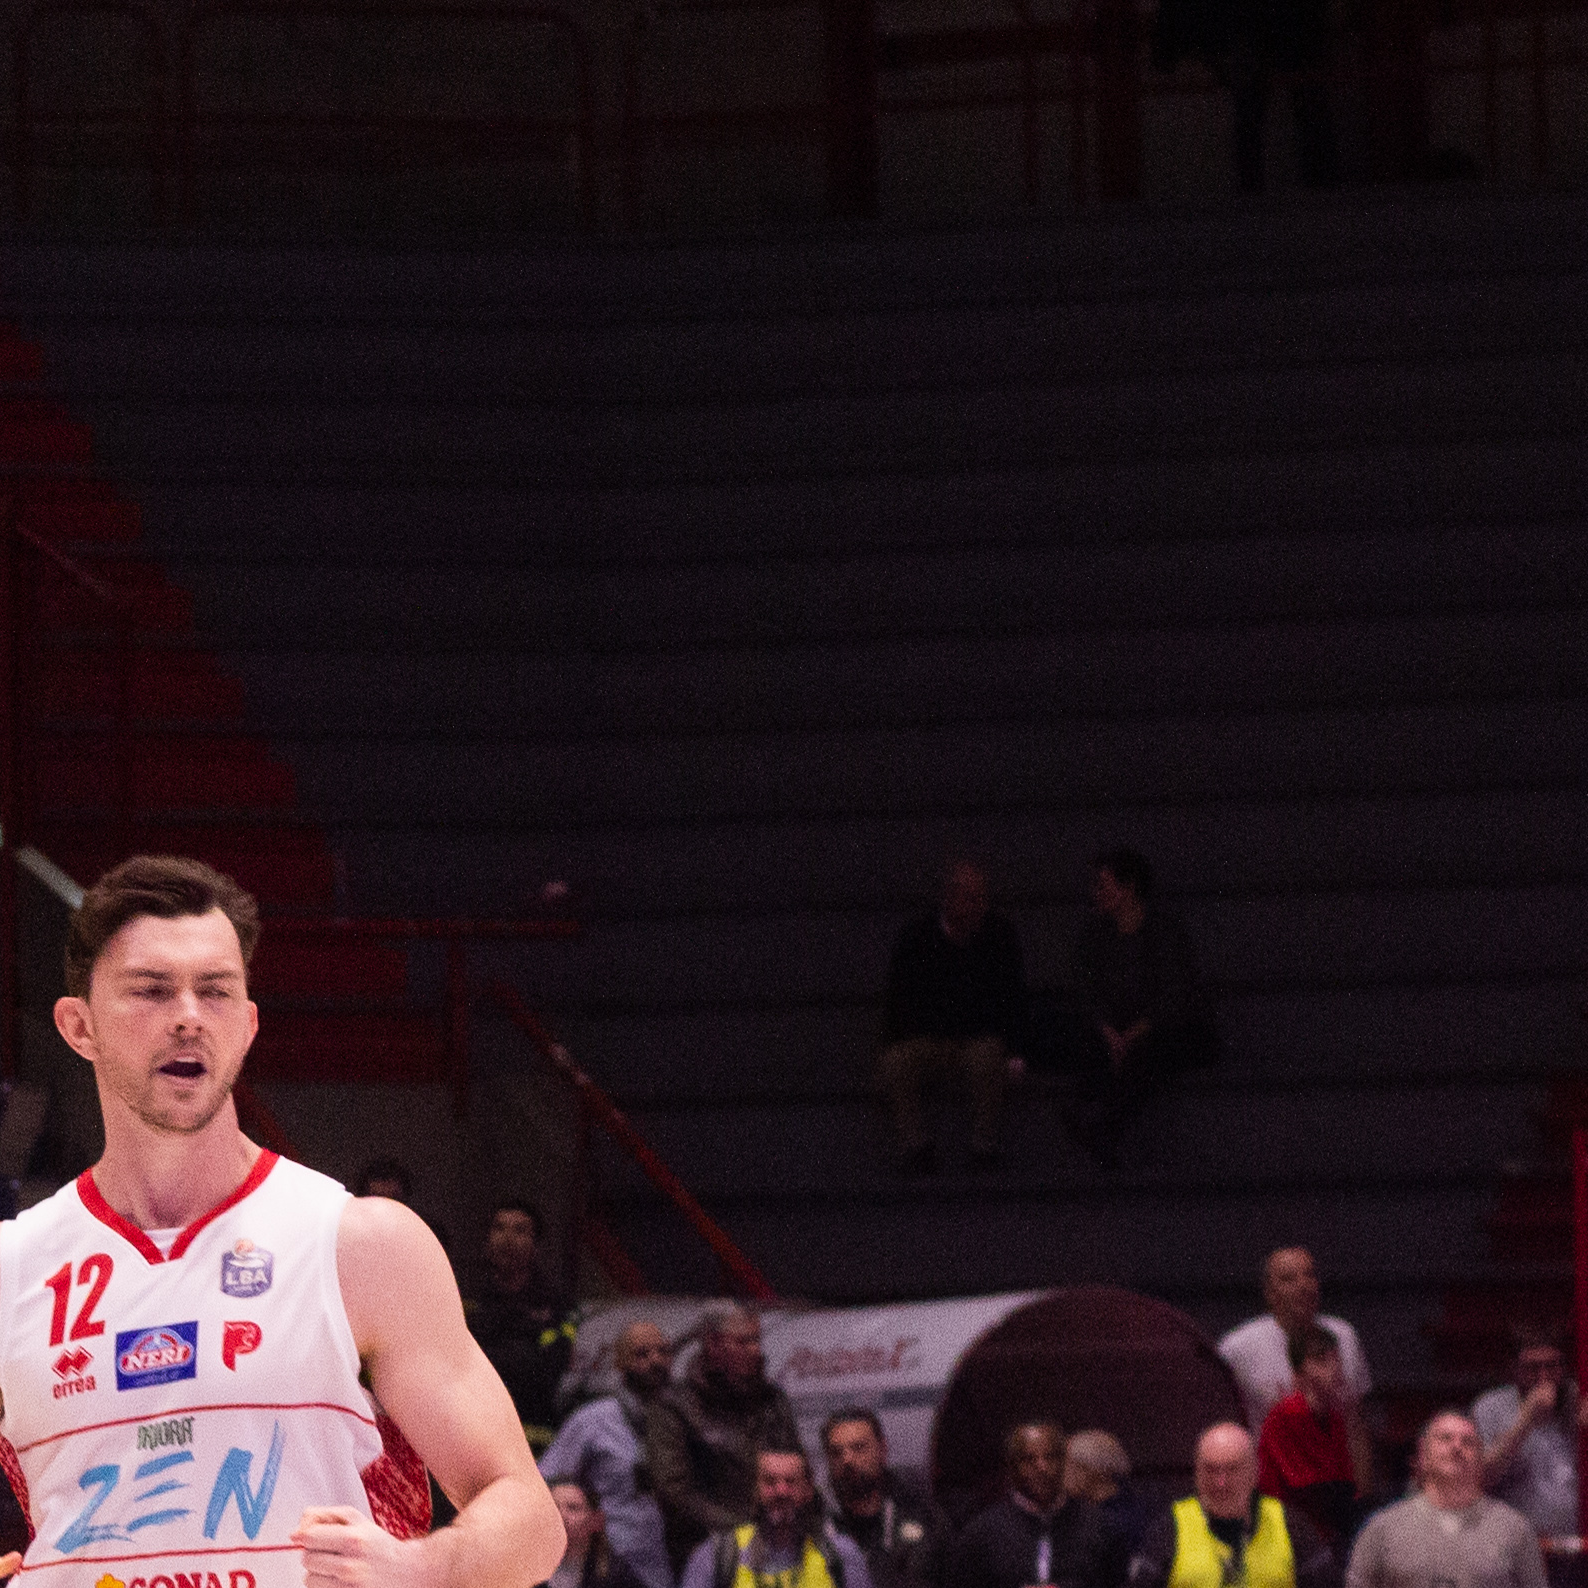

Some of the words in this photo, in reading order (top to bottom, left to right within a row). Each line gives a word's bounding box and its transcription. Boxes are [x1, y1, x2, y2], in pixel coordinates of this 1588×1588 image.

[225, 1269, 268, 1286] LBA
[44, 1252, 114, 1348] 12
[127, 1346, 187, 1371] NERI
